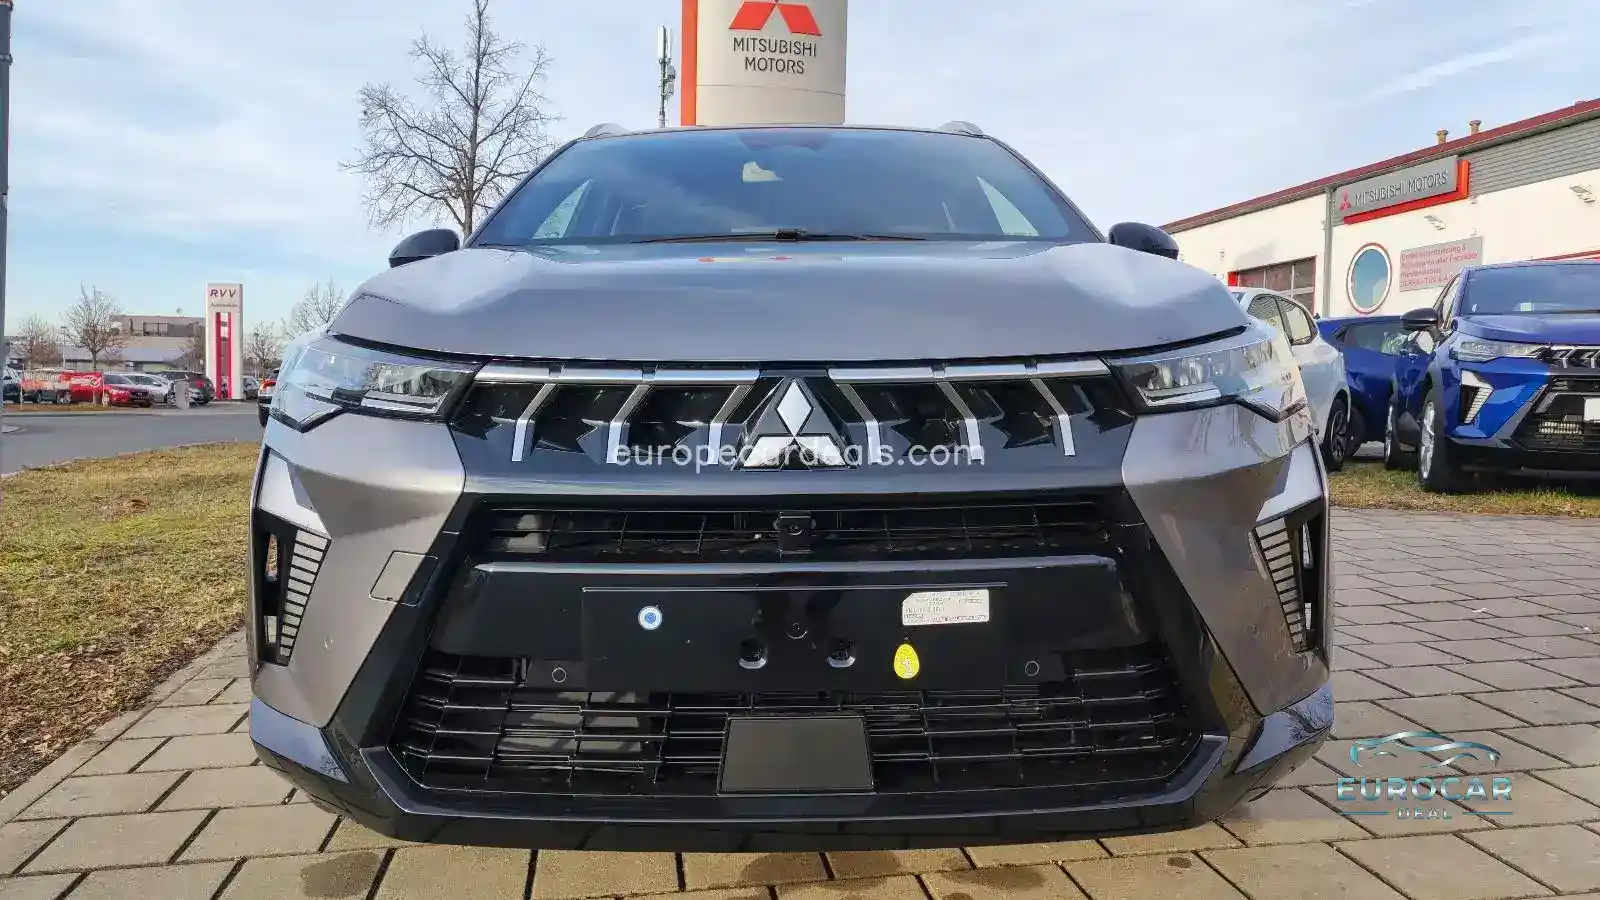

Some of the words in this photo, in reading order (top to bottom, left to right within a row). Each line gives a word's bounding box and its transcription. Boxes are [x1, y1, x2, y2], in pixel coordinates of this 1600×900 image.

[733, 37, 817, 57] MITSUBISHI
[744, 57, 805, 74] MOTORS
[1408, 170, 1448, 193] MOTORS
[210, 289, 237, 298] RVV
